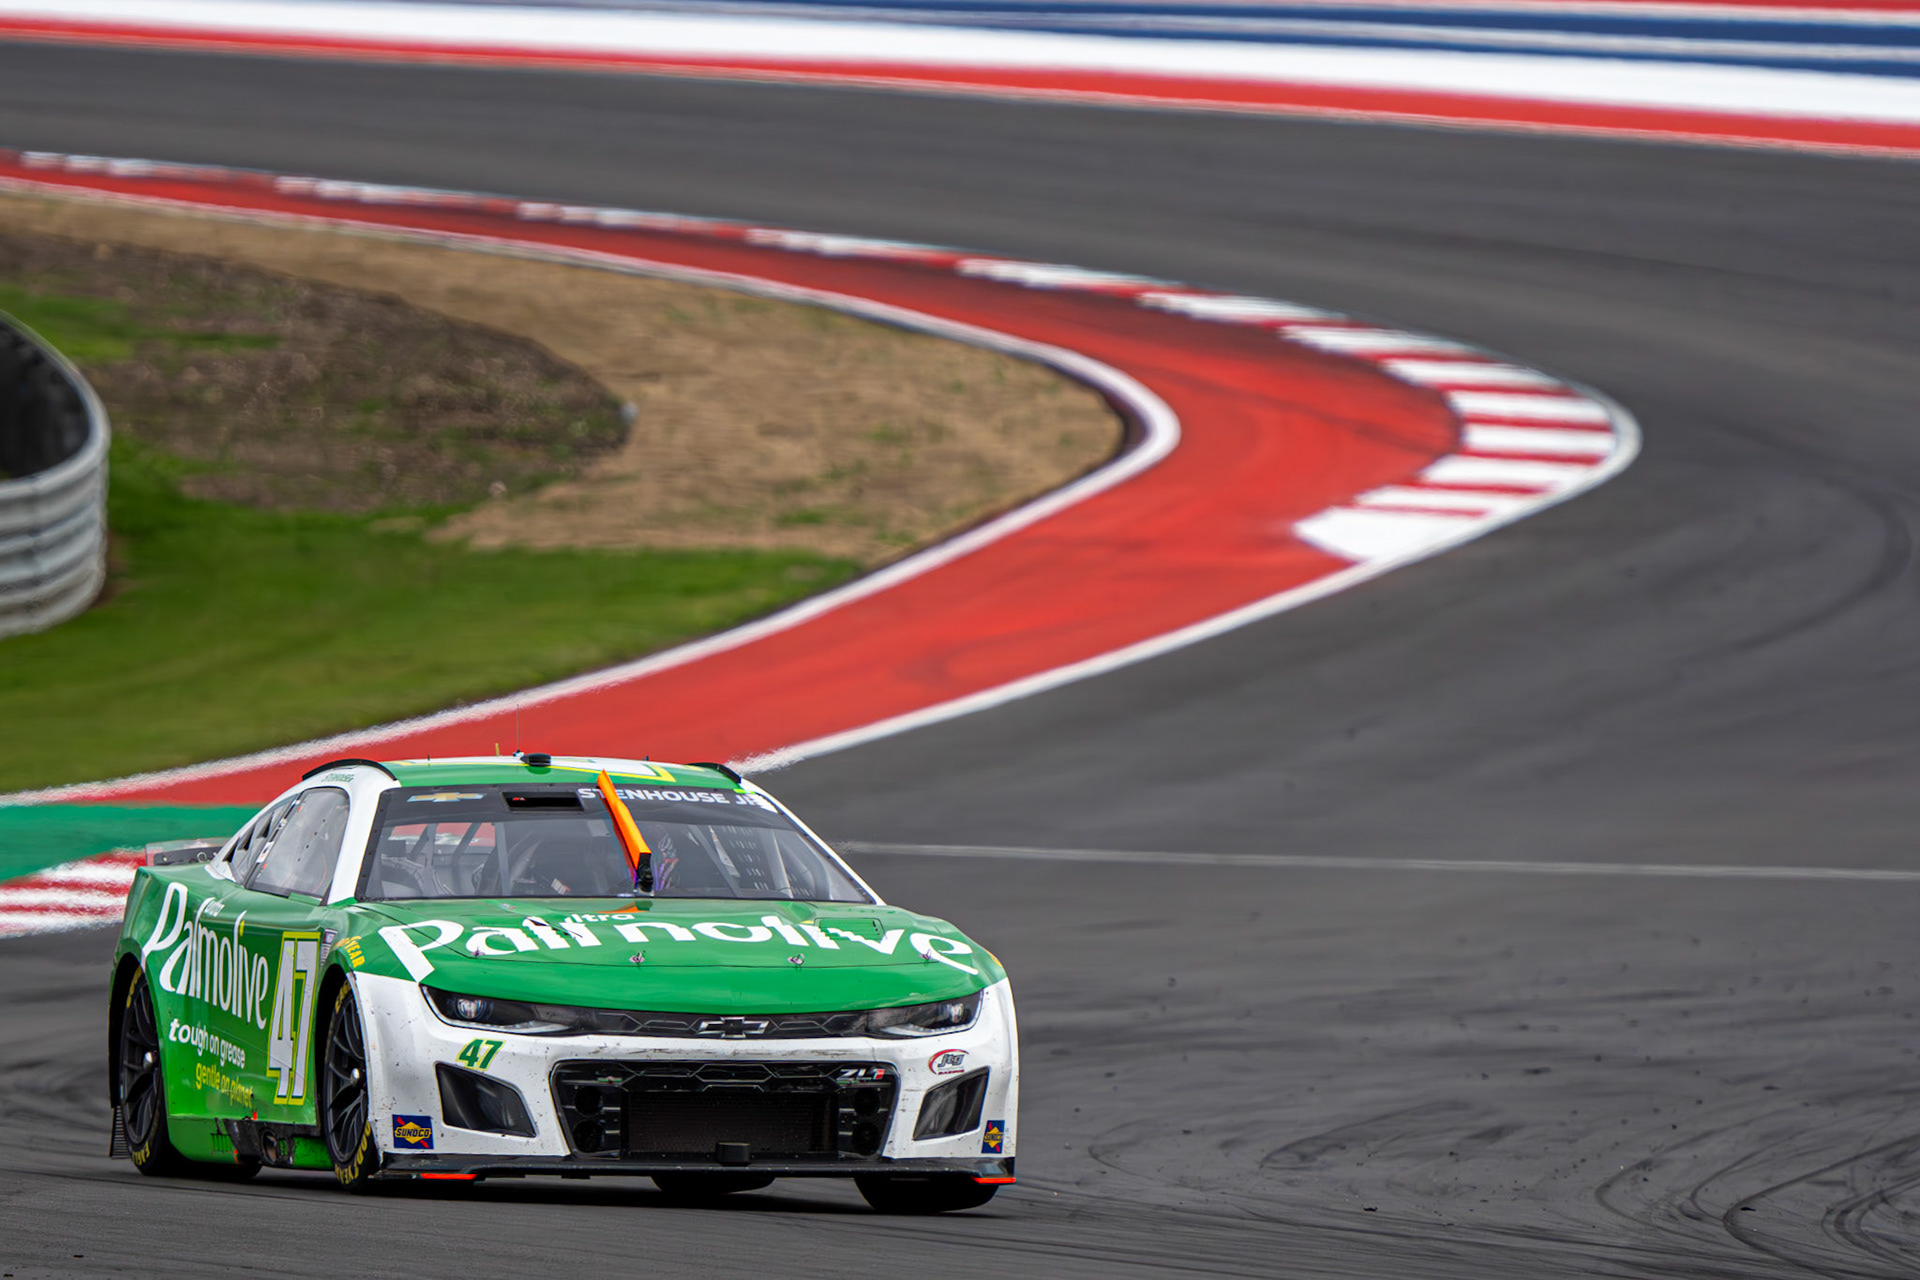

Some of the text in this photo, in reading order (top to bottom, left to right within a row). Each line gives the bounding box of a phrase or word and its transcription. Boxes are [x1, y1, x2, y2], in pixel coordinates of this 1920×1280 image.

[577, 788, 730, 804] STENHOUSE
[141, 882, 269, 1030] Palmolive
[266, 931, 321, 1105] 47
[168, 1018, 246, 1069] tough on grease
[456, 1038, 506, 1072] 47
[195, 1062, 220, 1091] gentle
[396, 1127, 431, 1138] SUNOCO
